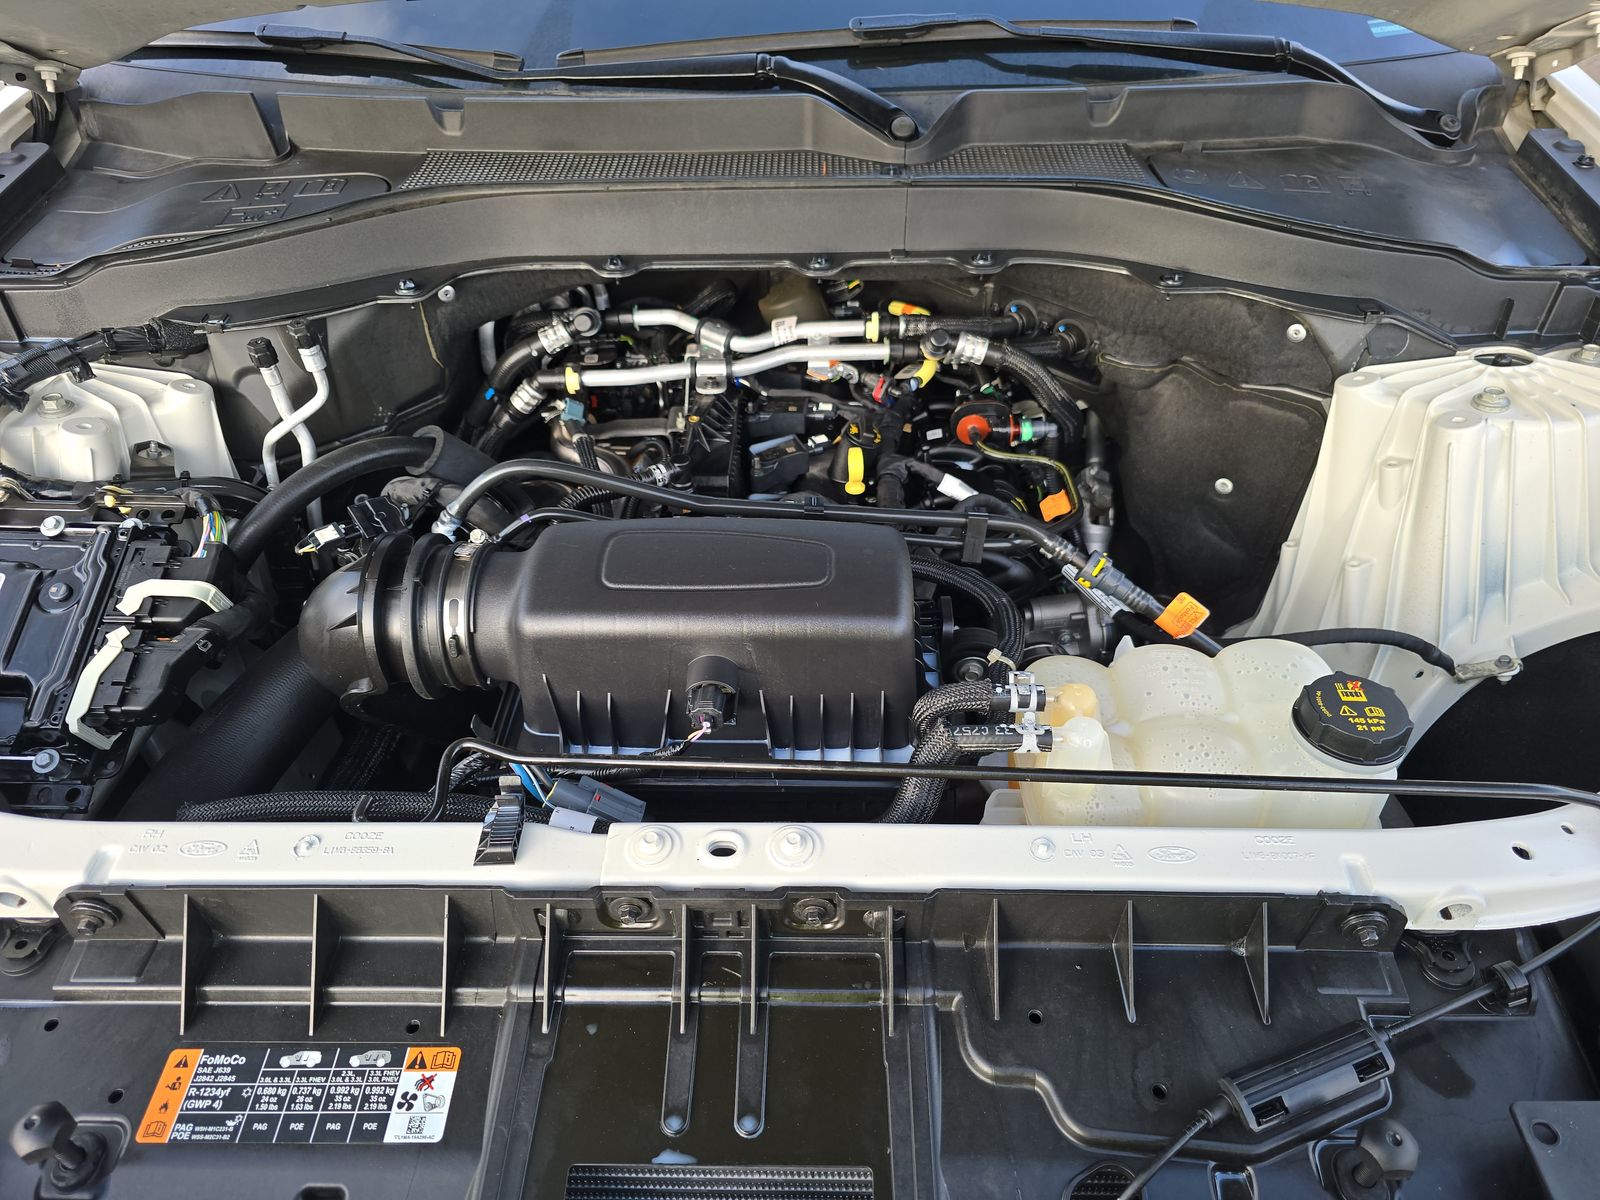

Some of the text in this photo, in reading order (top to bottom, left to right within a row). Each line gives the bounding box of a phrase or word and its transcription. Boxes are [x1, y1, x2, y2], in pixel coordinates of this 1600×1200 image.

[1366, 717, 1386, 725] kPa
[1071, 832, 1093, 842] LH
[199, 1055, 246, 1065] FoMoCo
[188, 1087, 232, 1098] R-1234yf
[256, 1087, 287, 1097] 0.680 kg
[291, 1087, 322, 1097] 0.737 kg
[329, 1086, 360, 1096] 0.992 kg
[365, 1086, 395, 1096] 0.992 kg
[182, 1100, 223, 1110] (GWP 4)
[174, 1123, 194, 1132] PAG
[289, 1123, 305, 1131] POE
[171, 1132, 191, 1140] POE
